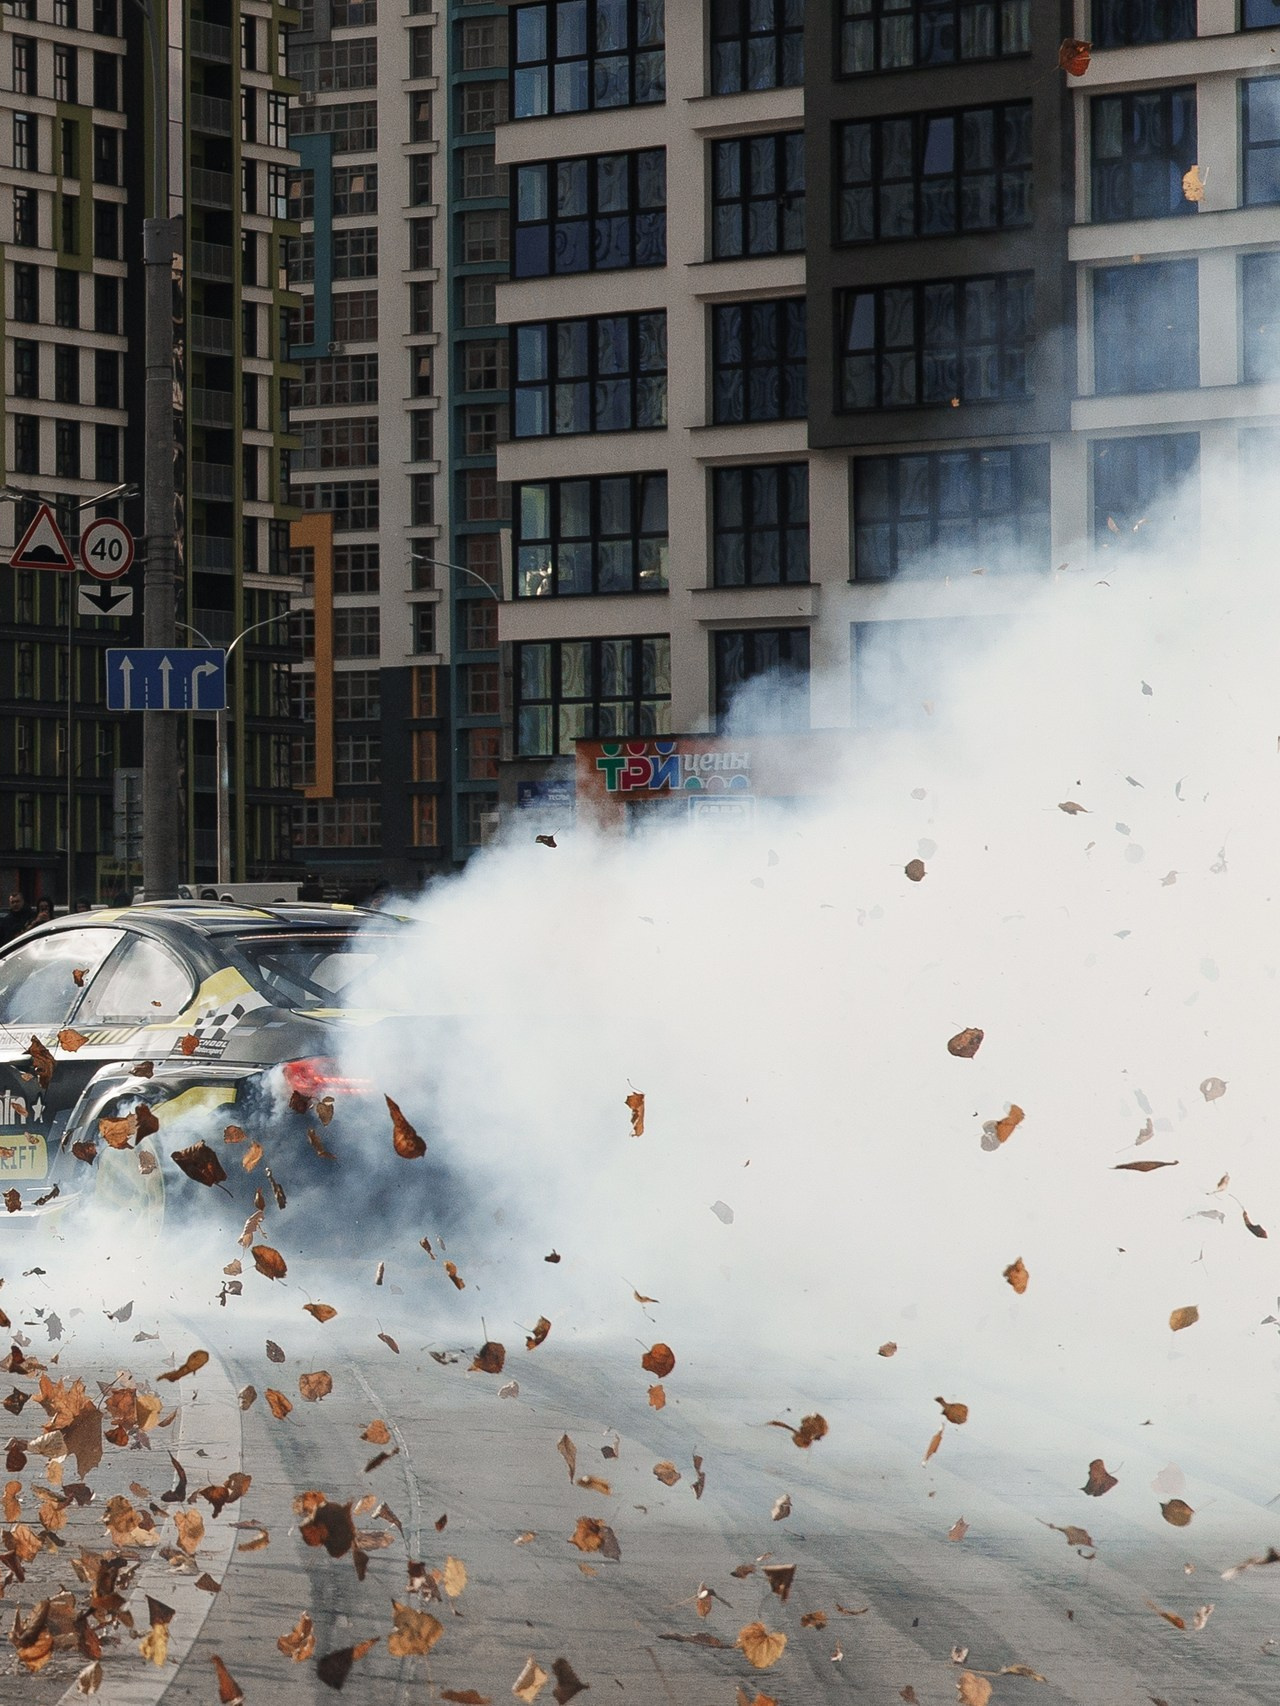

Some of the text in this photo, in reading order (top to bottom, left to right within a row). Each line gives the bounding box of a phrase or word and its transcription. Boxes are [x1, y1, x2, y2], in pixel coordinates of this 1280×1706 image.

[90, 538, 122, 561] 40
[595, 751, 752, 792] ТРИ цены
